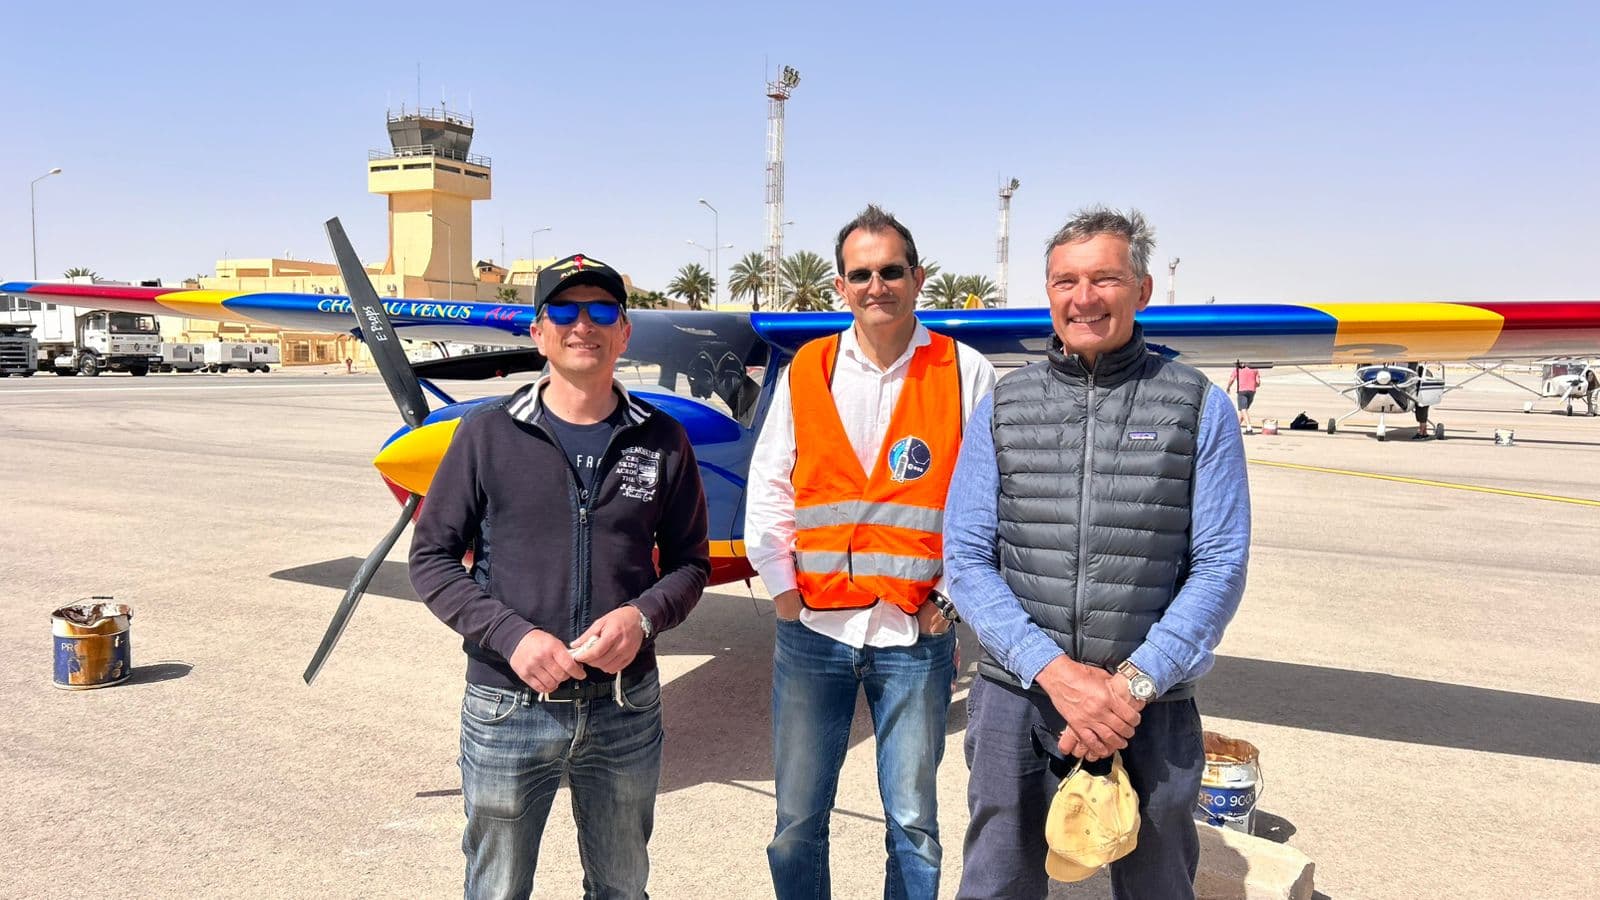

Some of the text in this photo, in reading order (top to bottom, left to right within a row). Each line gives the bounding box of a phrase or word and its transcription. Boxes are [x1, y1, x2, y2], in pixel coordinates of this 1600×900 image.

[317, 298, 523, 321] CHAAU VENUS Air
